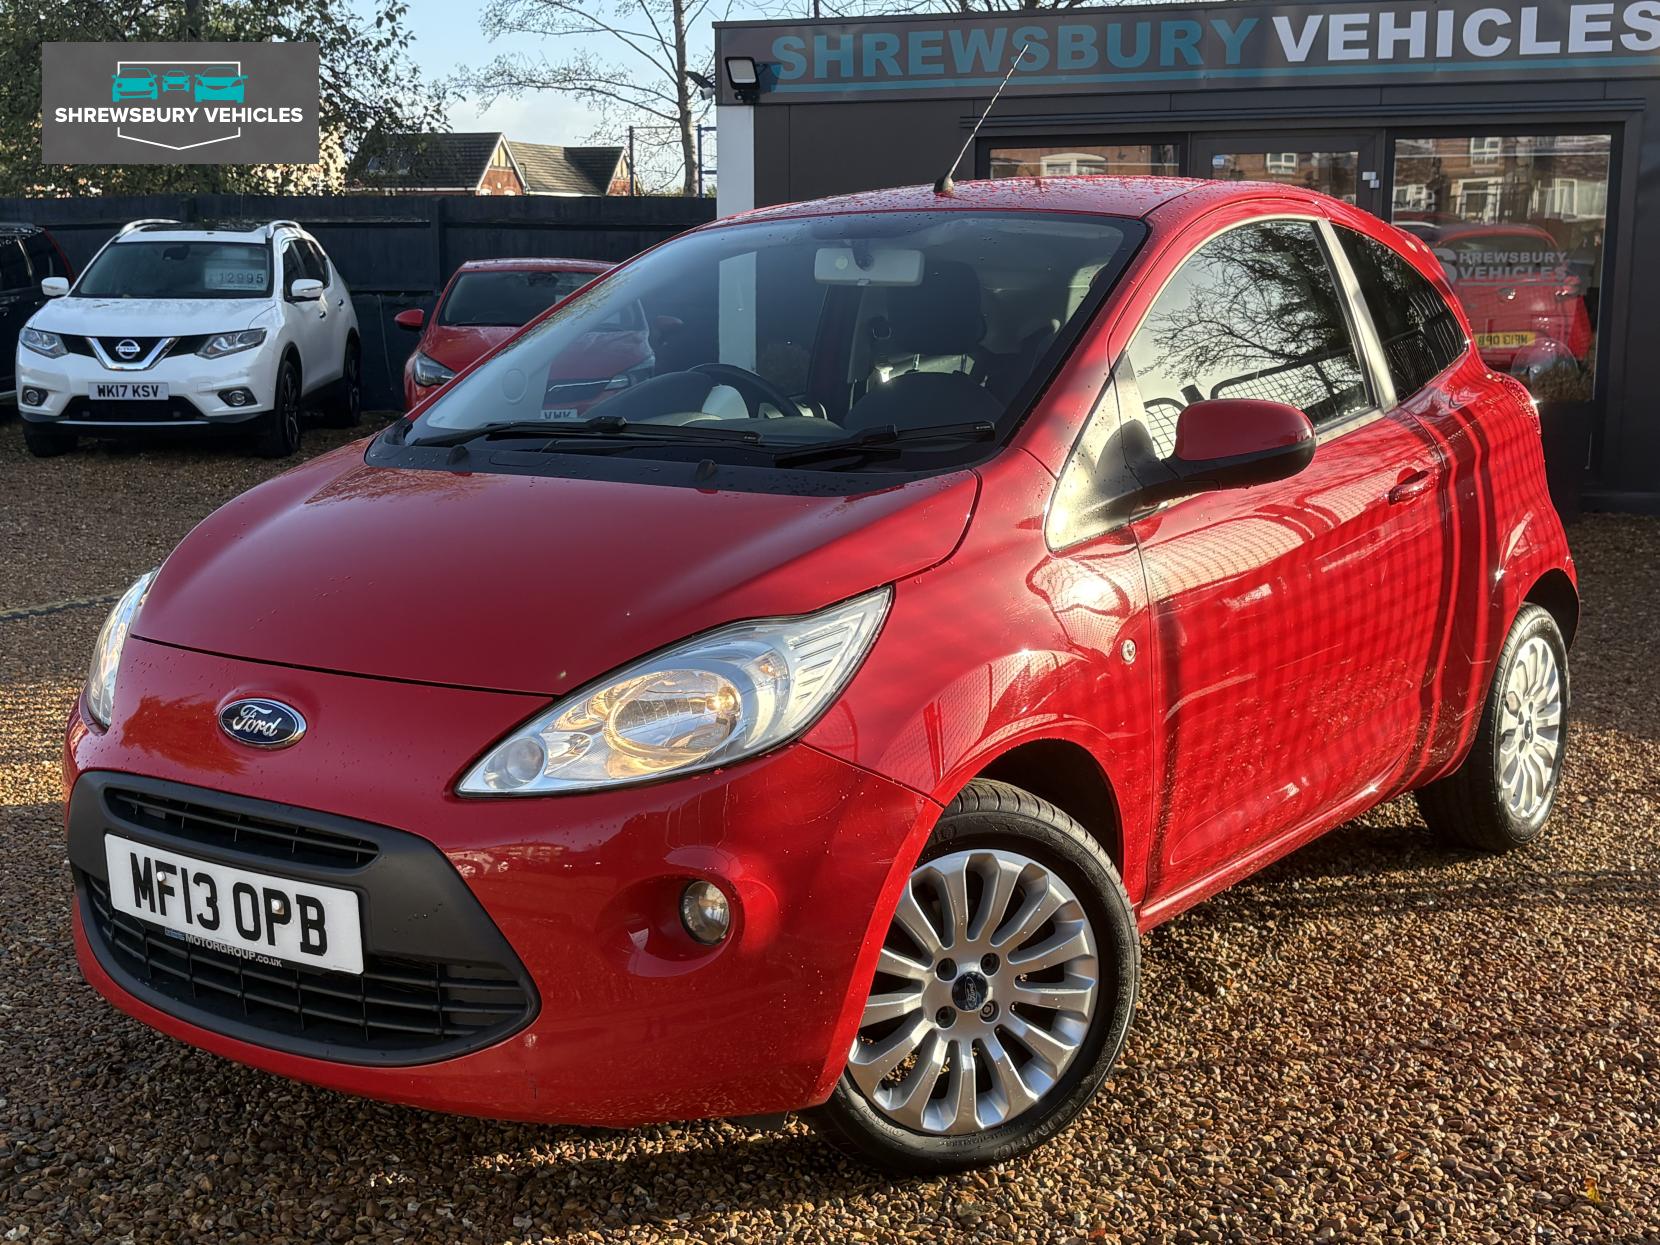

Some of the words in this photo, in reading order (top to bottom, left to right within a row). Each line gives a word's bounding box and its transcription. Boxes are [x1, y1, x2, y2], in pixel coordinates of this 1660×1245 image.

[770, 17, 1260, 81] SHREWSBURY
[1272, 0, 1660, 62] VEHICLES
[1459, 266, 1567, 280] VEHICLES
[97, 384, 128, 398] WK17
[132, 384, 159, 398] KSV
[232, 704, 282, 737] Ford
[129, 852, 221, 932] MF13
[232, 880, 328, 958] OPB
